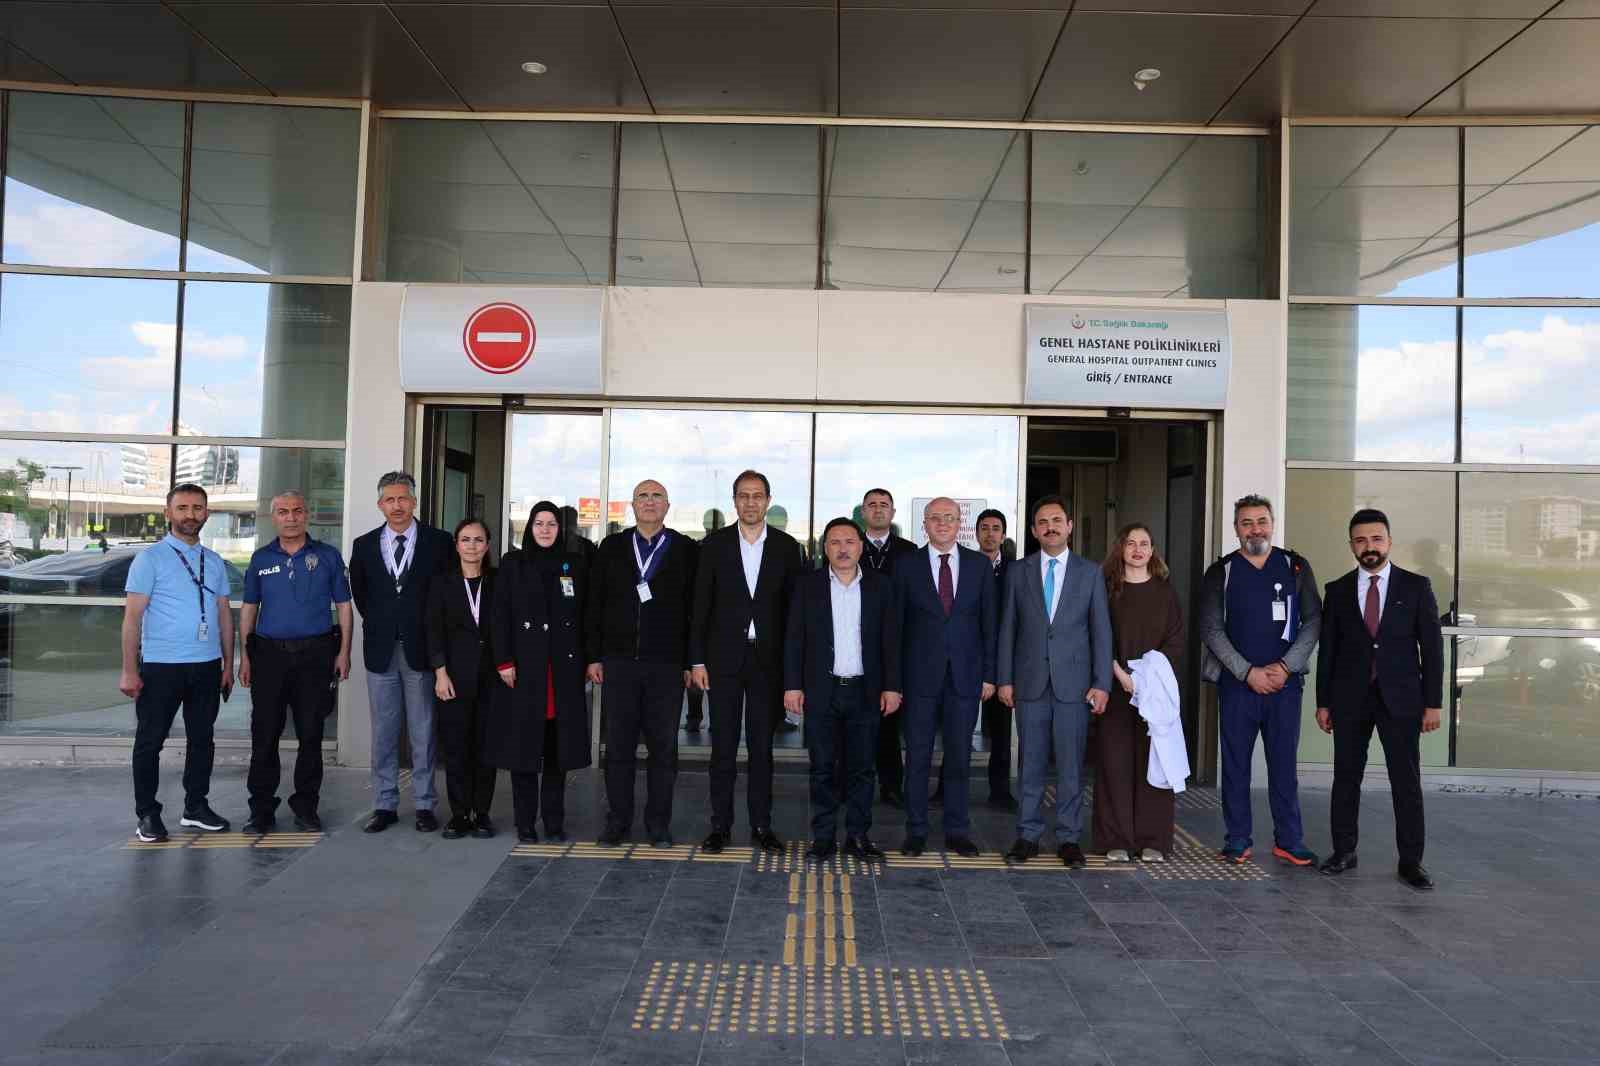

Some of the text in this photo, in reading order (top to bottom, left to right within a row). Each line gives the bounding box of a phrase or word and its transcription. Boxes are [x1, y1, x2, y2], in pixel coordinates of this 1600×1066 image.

[1039, 337, 1221, 352] GENEL HASTANE POLİKLİNİKLERİ
[1047, 354, 1217, 368] GENERAL HOSPITAL OUTPATIENT CLINICS
[1086, 372, 1173, 384] GİRİŞ / ENTRANCE
